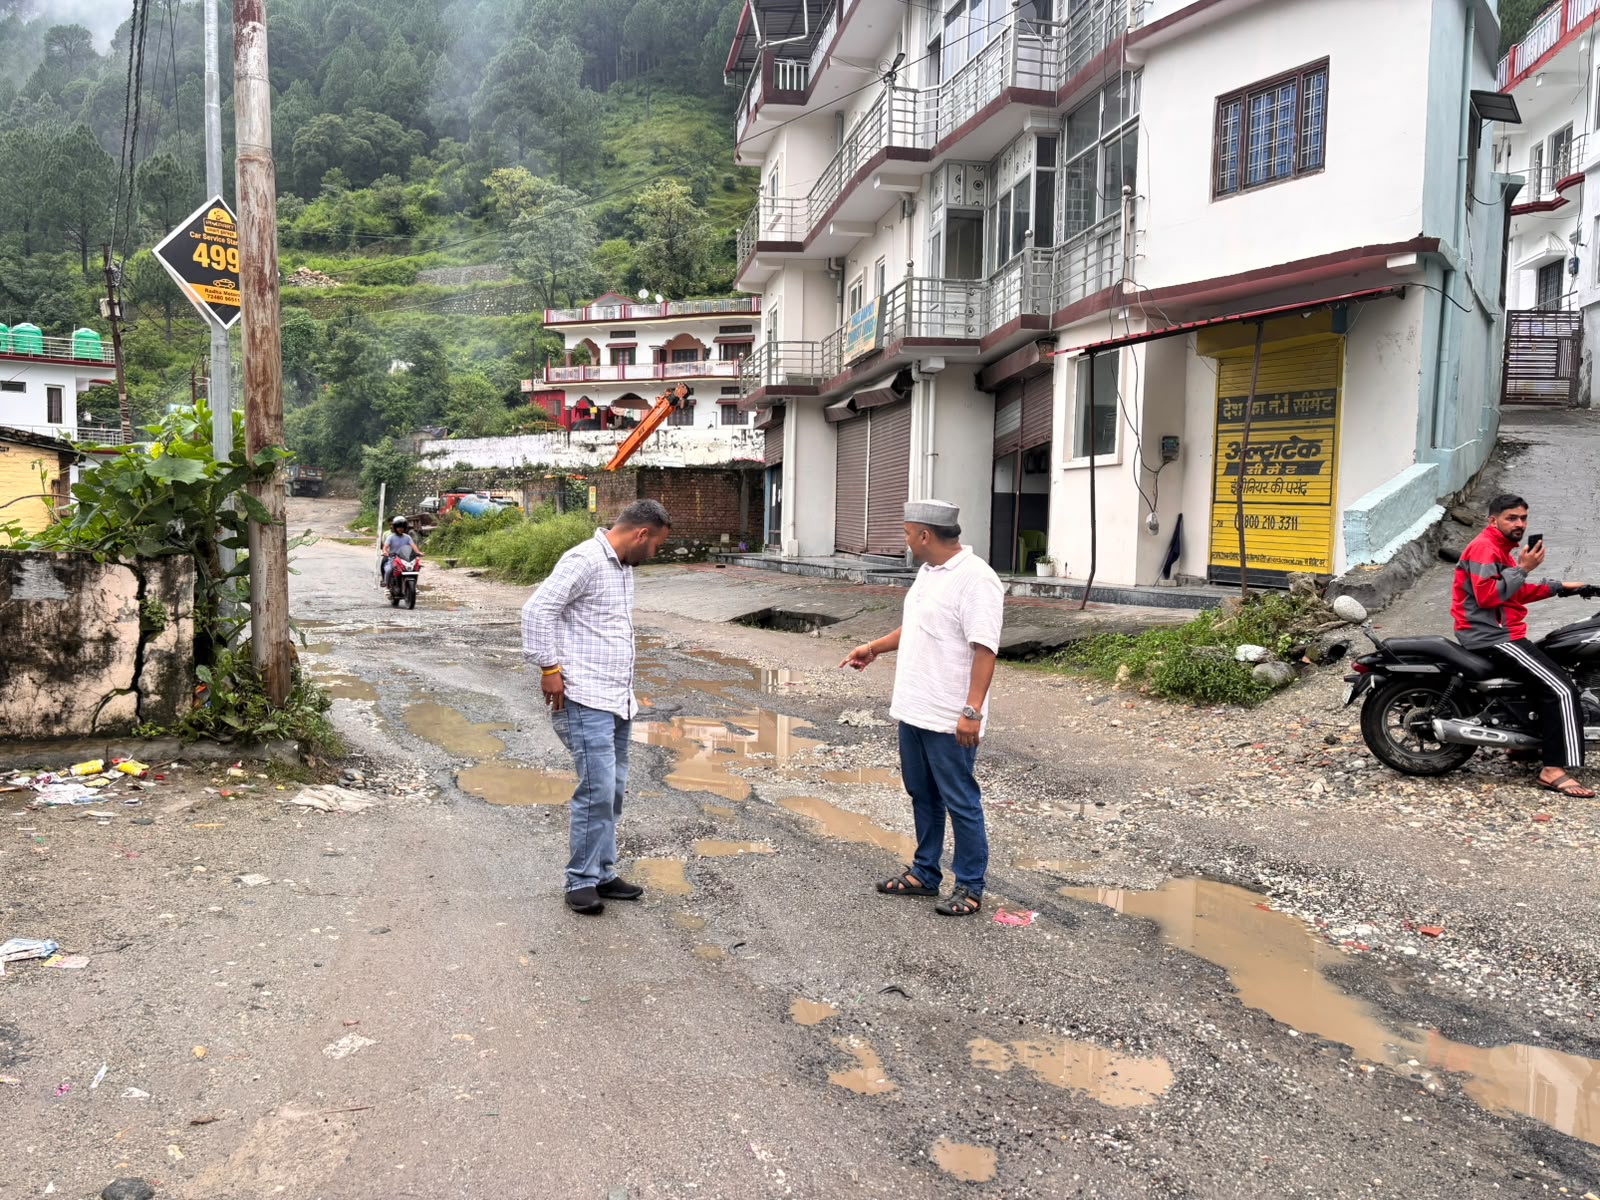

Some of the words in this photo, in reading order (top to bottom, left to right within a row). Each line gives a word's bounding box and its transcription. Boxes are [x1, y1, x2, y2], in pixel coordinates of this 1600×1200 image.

[189, 231, 202, 240] Car
[202, 233, 226, 243] Service
[192, 242, 240, 274] 499
[204, 288, 223, 296] Radha
[1222, 398, 1243, 420] देश
[1270, 477, 1284, 494] की
[1262, 515, 1276, 530] 210
[1278, 515, 1298, 531] 3311
